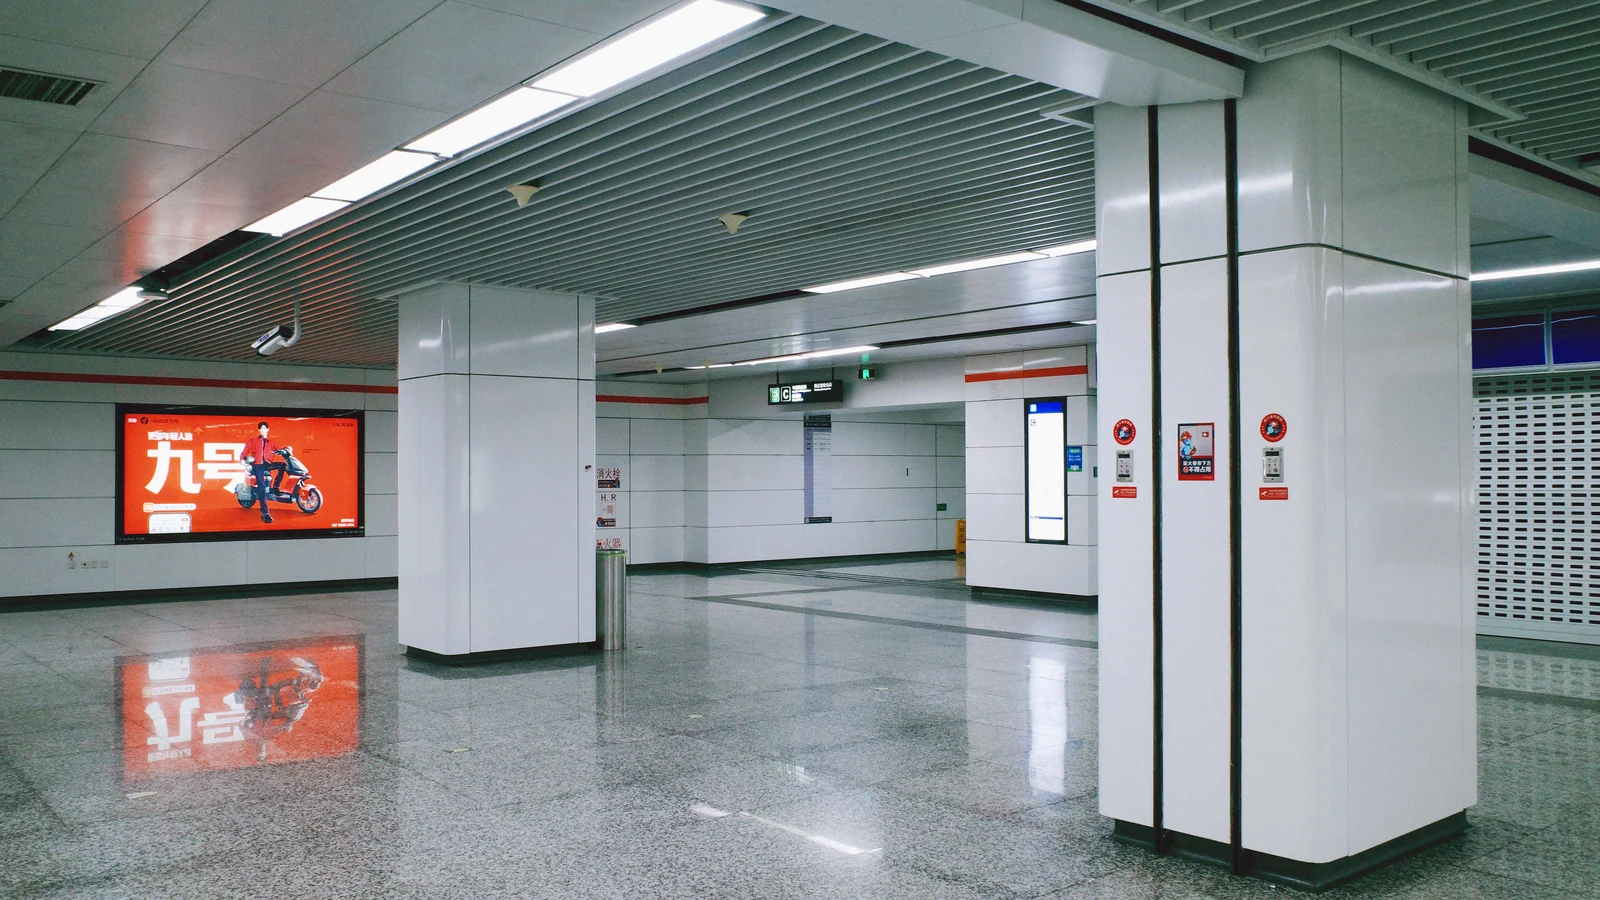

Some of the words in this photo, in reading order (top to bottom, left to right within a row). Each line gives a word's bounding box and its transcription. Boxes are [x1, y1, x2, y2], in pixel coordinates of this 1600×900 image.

[782, 389, 789, 399] C
[145, 441, 247, 495] 九号
[597, 468, 621, 479] 消火栓
